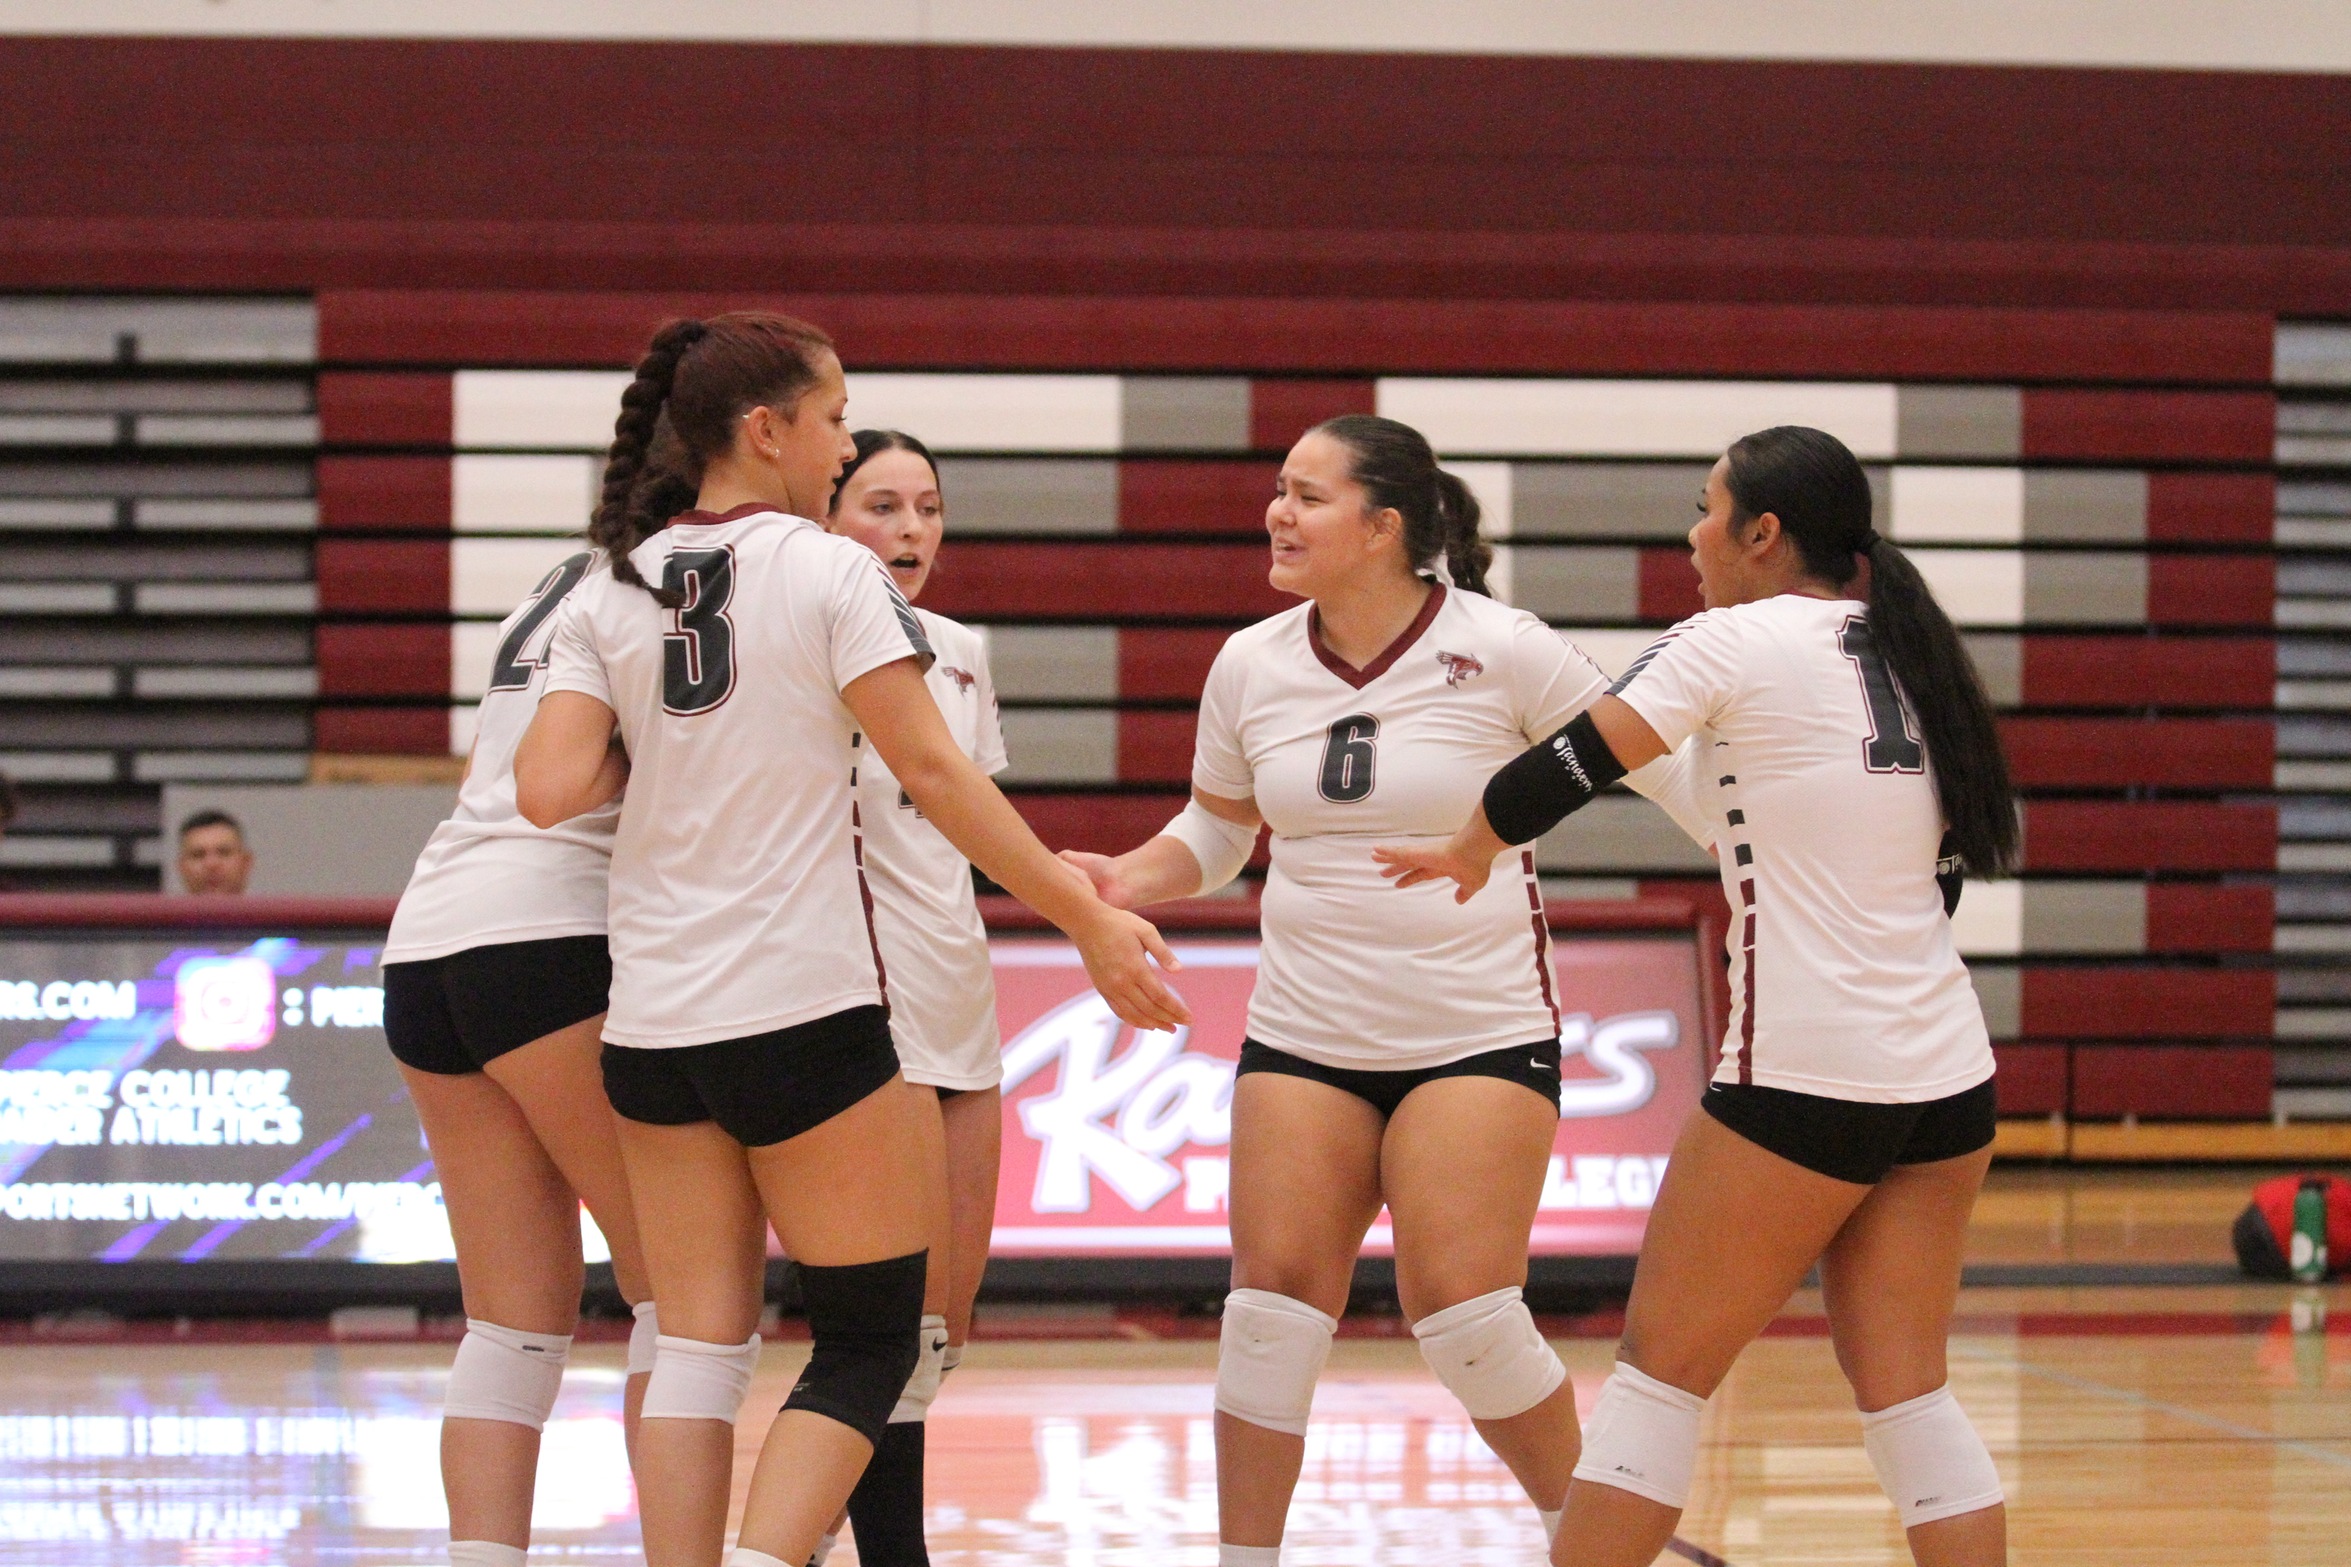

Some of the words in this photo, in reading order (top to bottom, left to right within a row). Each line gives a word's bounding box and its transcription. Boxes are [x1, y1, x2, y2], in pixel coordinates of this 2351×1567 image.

[662, 543, 737, 717] 3
[1317, 711, 1381, 804] 6
[120, 1069, 291, 1108] COLLEGE
[110, 1105, 303, 1146] ATHLETICS
